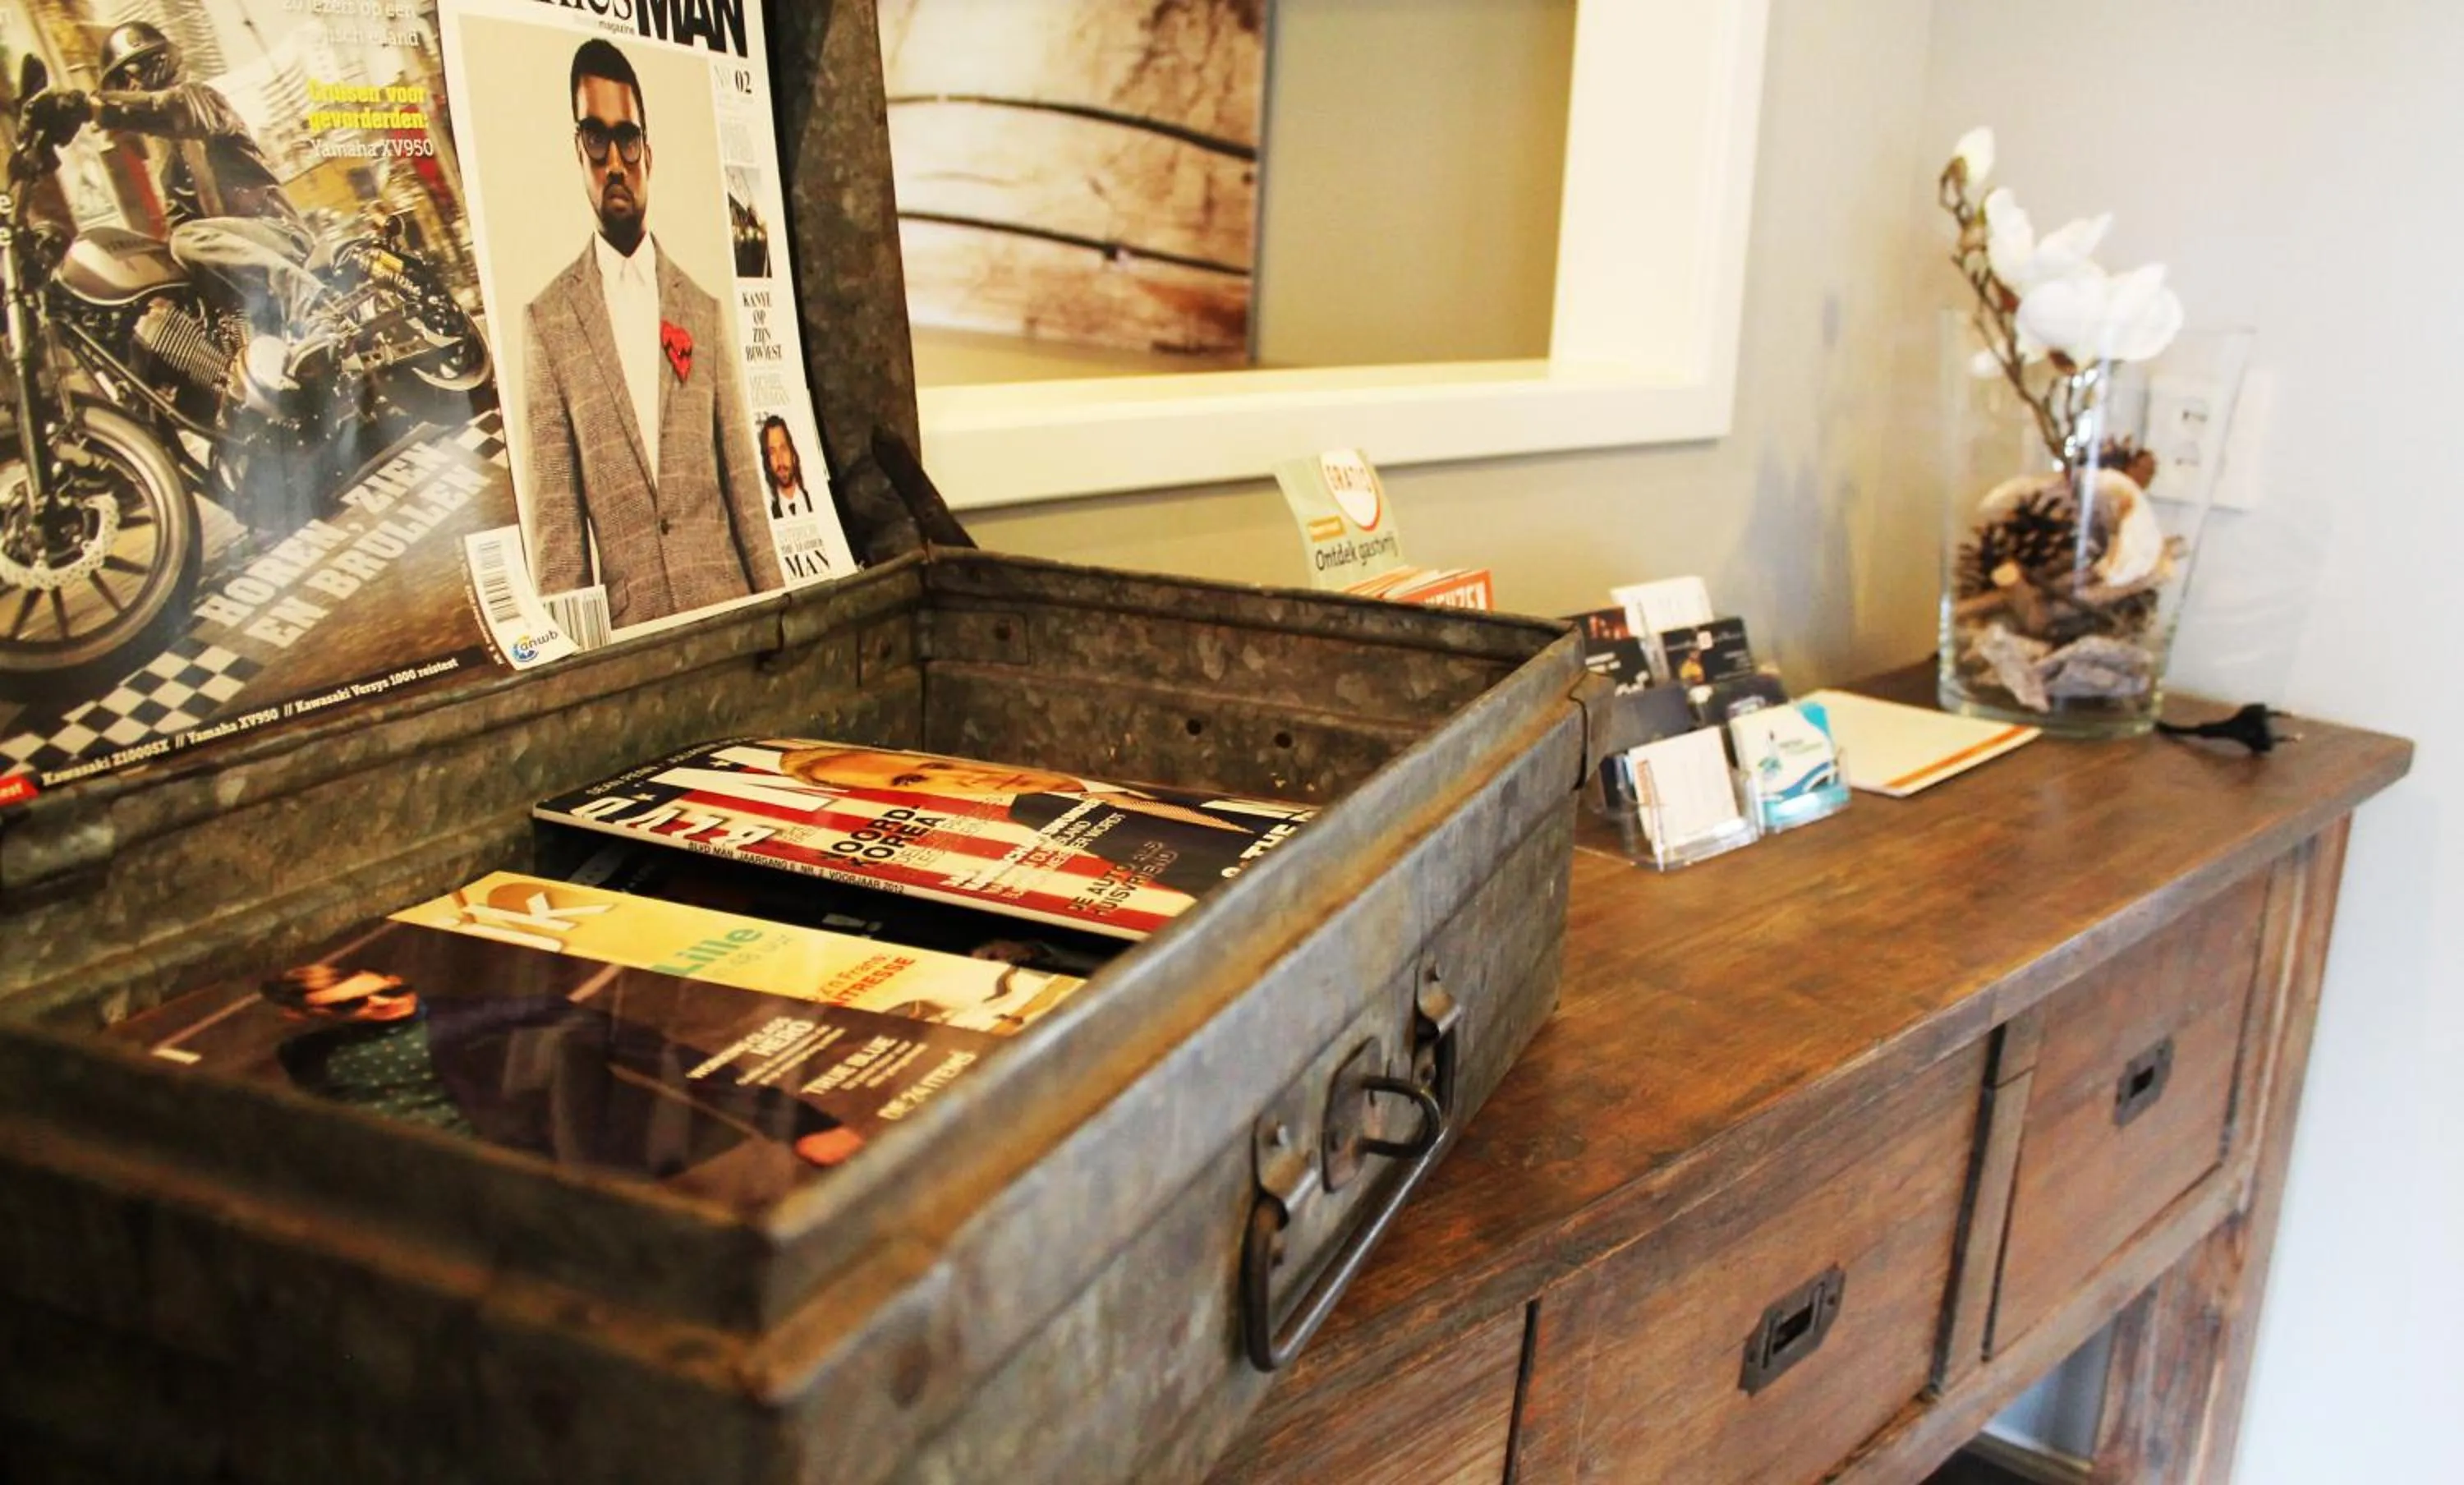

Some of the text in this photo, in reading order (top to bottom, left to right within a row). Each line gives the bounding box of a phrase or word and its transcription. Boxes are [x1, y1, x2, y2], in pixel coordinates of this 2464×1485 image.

[599, 21, 636, 35] magazine
[307, 80, 427, 104] Cruisen voor
[735, 70, 752, 94] 02
[307, 108, 430, 134] gevorderden:
[309, 138, 434, 159] Yamaha XV950
[752, 309, 767, 326] OP
[193, 519, 364, 628] HOREN,
[339, 441, 452, 515] ZIEN
[244, 598, 331, 649] EN
[305, 464, 492, 600] BRULLEN
[784, 549, 832, 580] MAN
[1315, 542, 1357, 571] Ontdek
[520, 629, 559, 651] anwb
[42, 757, 111, 787] Kawasaki
[186, 722, 237, 745] Yamaha
[237, 707, 279, 731] XV950
[295, 687, 352, 714] Kawasaki
[351, 679, 389, 697] Versys
[388, 668, 417, 687] 1000
[687, 842, 711, 853] BLVD
[712, 846, 734, 859] MAN
[828, 870, 881, 890] VOORJAAR
[650, 928, 763, 978] Lille
